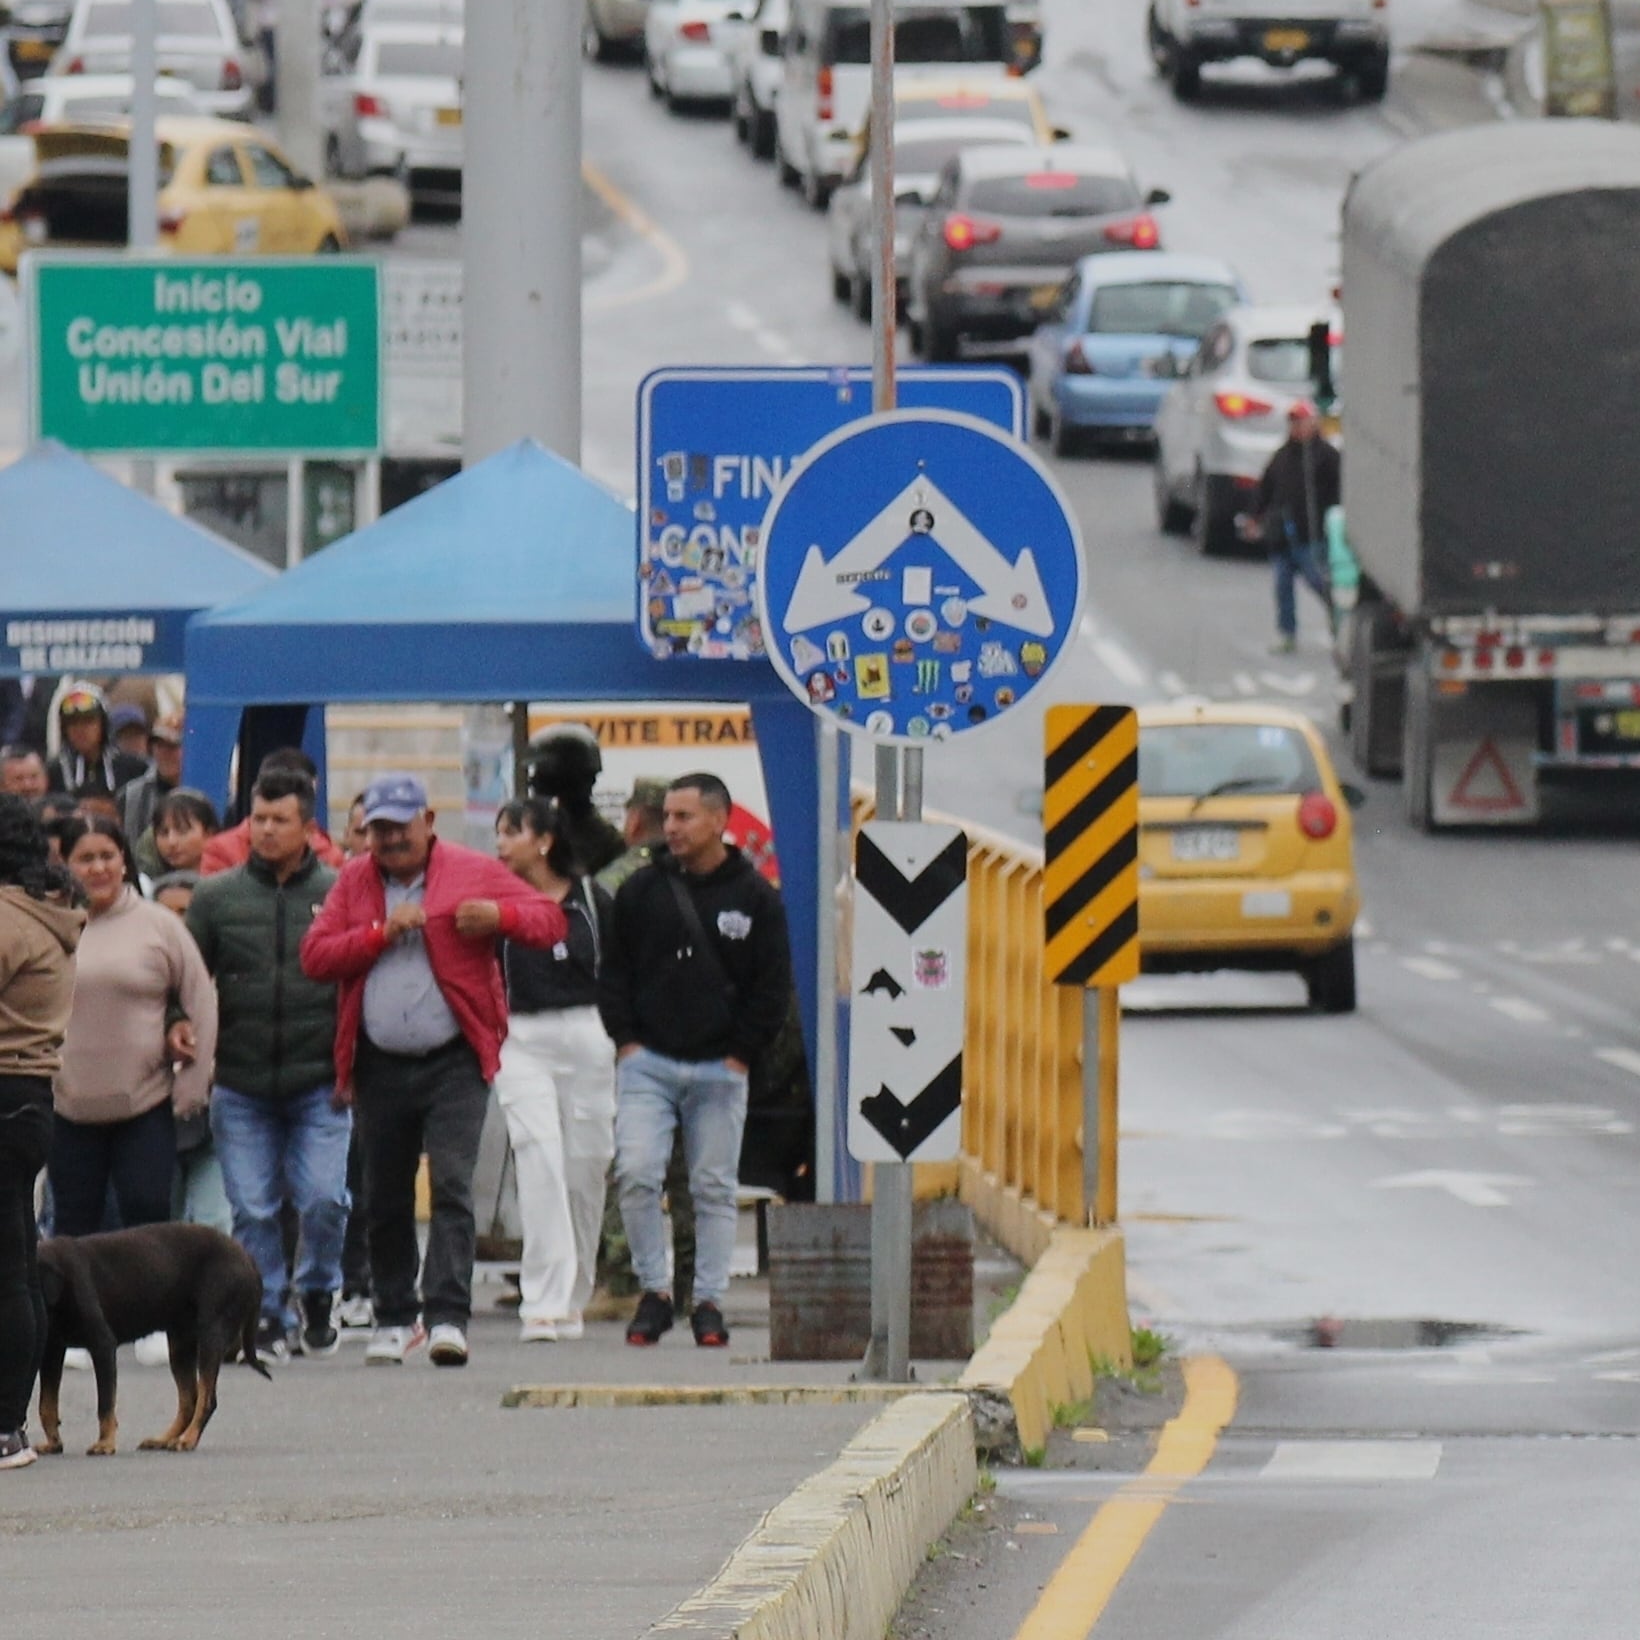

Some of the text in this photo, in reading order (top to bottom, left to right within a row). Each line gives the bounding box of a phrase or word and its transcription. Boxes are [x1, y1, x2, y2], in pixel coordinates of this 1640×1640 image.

[155, 272, 262, 313] Inicio
[66, 316, 348, 359] Concesión Vial
[79, 362, 342, 404] Unión Del Sur
[580, 718, 659, 743] VITE
